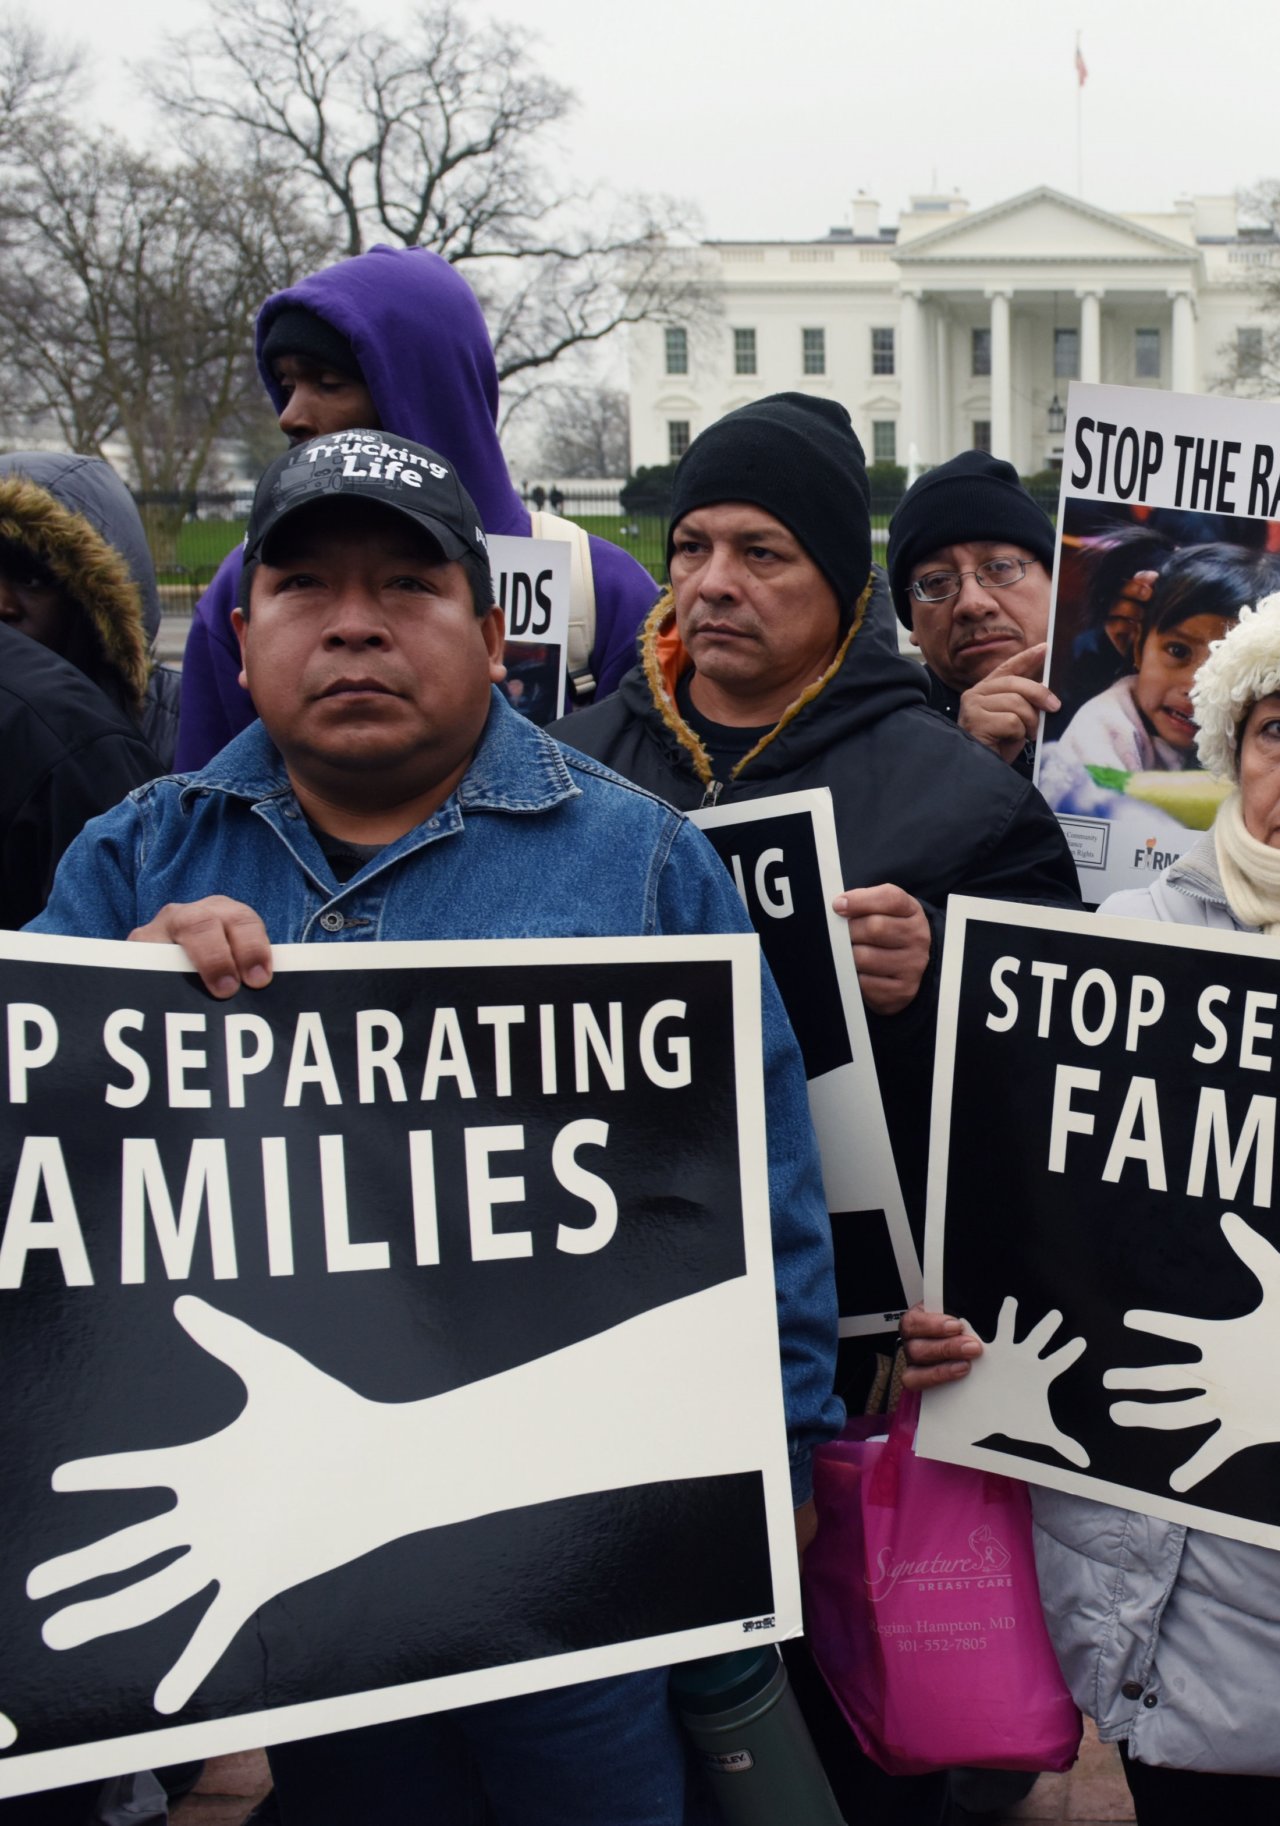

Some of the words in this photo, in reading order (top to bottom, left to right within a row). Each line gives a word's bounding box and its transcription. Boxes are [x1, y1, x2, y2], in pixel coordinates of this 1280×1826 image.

[331, 432, 376, 445] The
[305, 441, 449, 480] Trucking
[342, 455, 424, 488] Life
[1072, 417, 1164, 502] STOP
[1175, 435, 1242, 514] THE
[986, 956, 1166, 1052] STOP
[104, 1000, 692, 1109] SEPARATING
[0, 1119, 618, 1290] AMILIES
[864, 1547, 972, 1602] Signature
[918, 1581, 971, 1592] BREAST
[977, 1578, 1013, 1589] CARE
[989, 1616, 1016, 1630] MD
[896, 1637, 988, 1653] 301-552-7805
